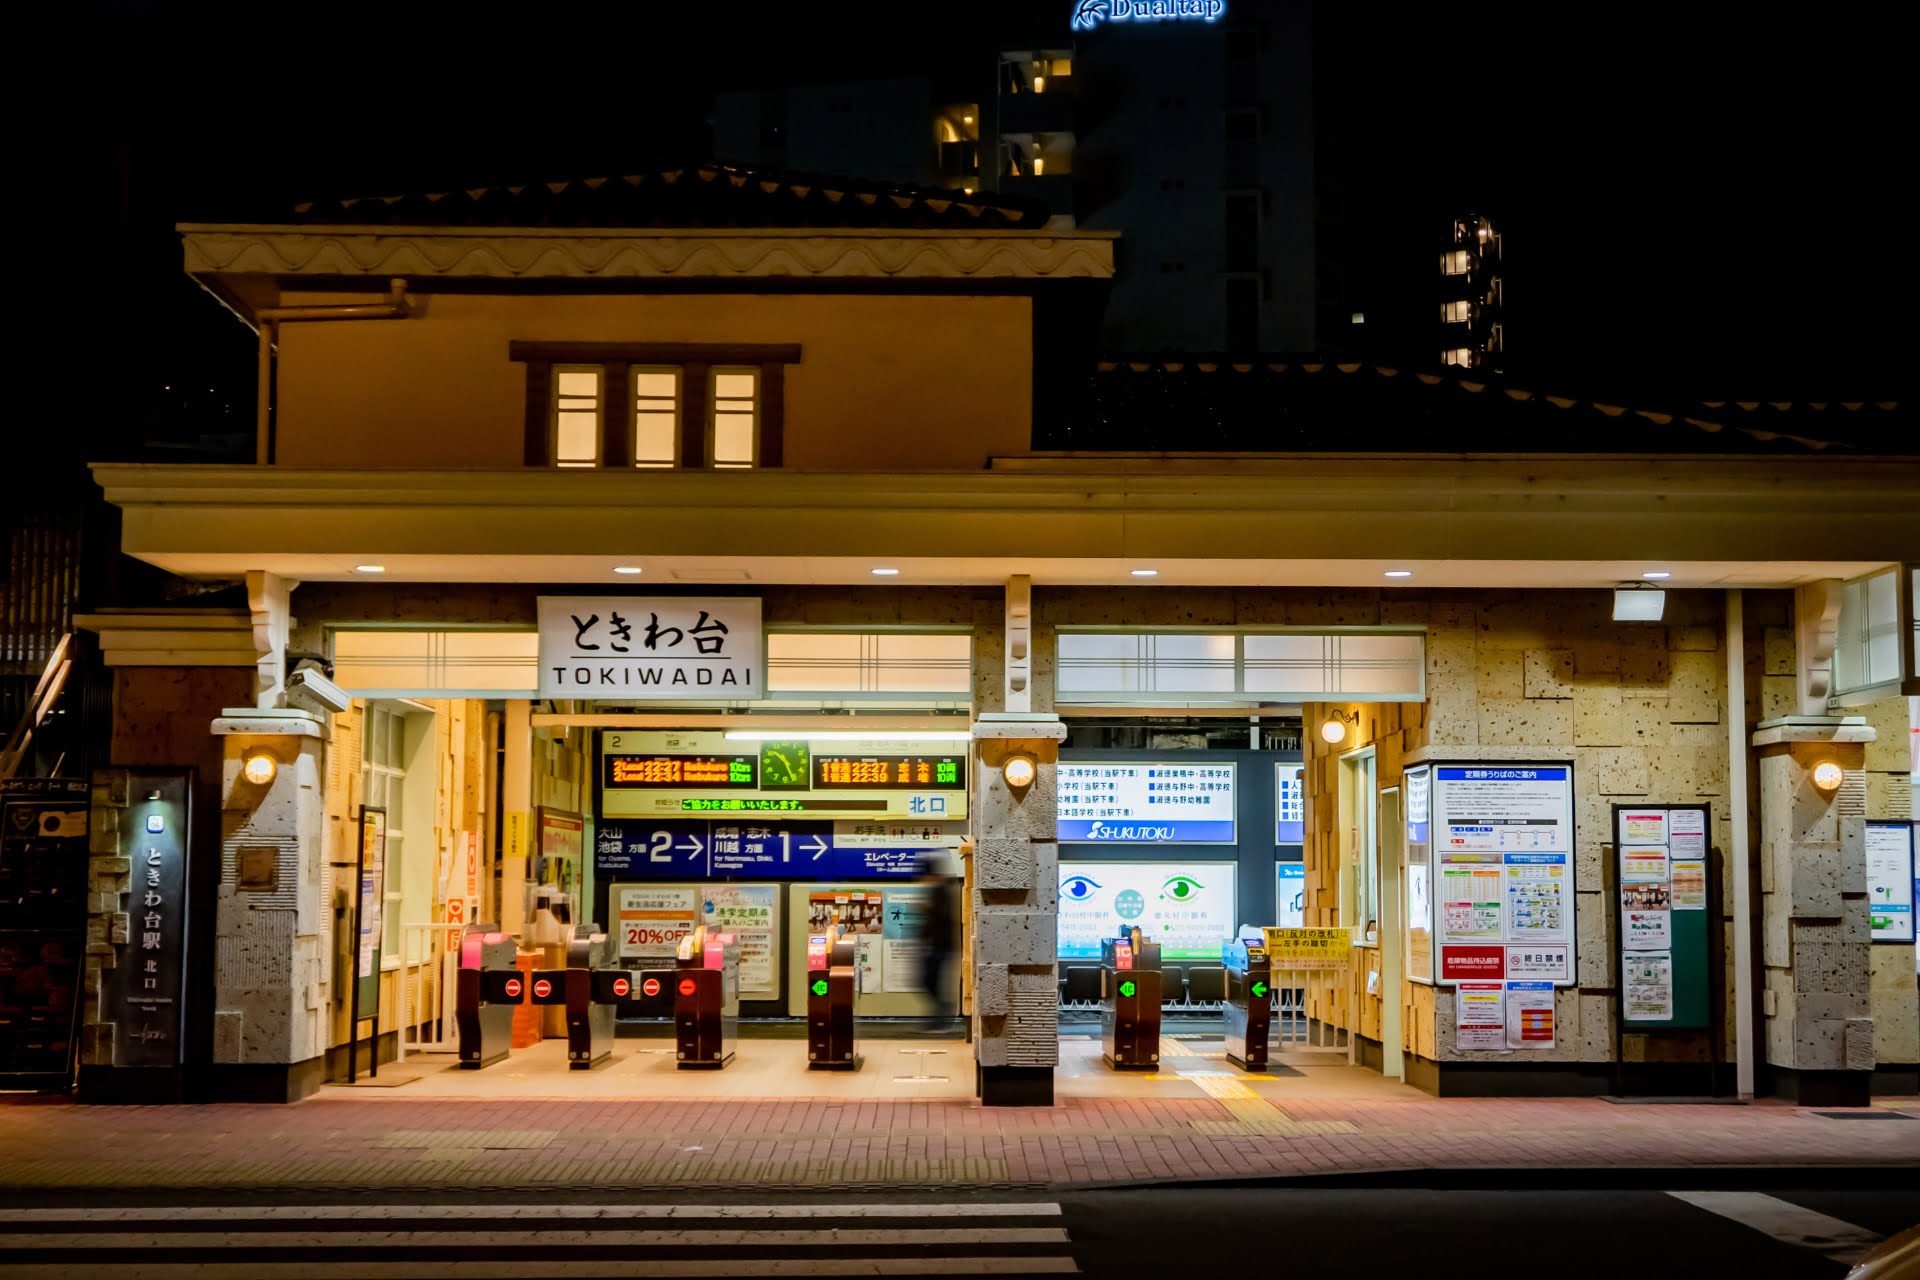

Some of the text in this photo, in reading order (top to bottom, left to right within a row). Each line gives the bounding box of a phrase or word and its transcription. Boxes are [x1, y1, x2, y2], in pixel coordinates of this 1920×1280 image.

[1109, 0, 1223, 20] Dualtap
[570, 611, 728, 654] ときわ台
[553, 667, 750, 685] TOKIWADAI
[612, 736, 621, 748] 2
[613, 761, 622, 772] 2
[622, 761, 645, 772] Local
[644, 761, 682, 772] 22:27
[683, 762, 729, 772] Ikebukuro
[822, 762, 829, 773] 1
[831, 762, 851, 773] 普通
[852, 762, 888, 773] 22:27
[937, 763, 956, 773] 10両
[613, 772, 622, 782] 2
[622, 772, 645, 781] Local
[644, 772, 682, 782] 22:34
[683, 772, 729, 781] Ikebukuro
[822, 773, 829, 783] 1
[831, 773, 851, 783] 普通
[852, 773, 888, 783] 22:39
[937, 773, 956, 783] 10両
[1465, 770, 1537, 779] 定期券うりばのご案内
[1155, 783, 1231, 791] 淑徳与野中・高等学校
[682, 799, 804, 811] ご協力をお願いいたします。
[909, 796, 945, 813] 北口
[1155, 796, 1211, 804] 淑徳与野幼稚園
[599, 827, 622, 839] 大山
[854, 825, 887, 836] お手洗
[599, 841, 647, 853] 池袋 方面
[651, 830, 672, 862] 2
[714, 841, 764, 853] 川越 方面
[779, 831, 790, 862] 1
[142, 848, 162, 989] ときわ台駅 北口
[1115, 946, 1131, 957] IC
[1524, 954, 1564, 963] 終日禁煙
[1124, 985, 1133, 993] IC
